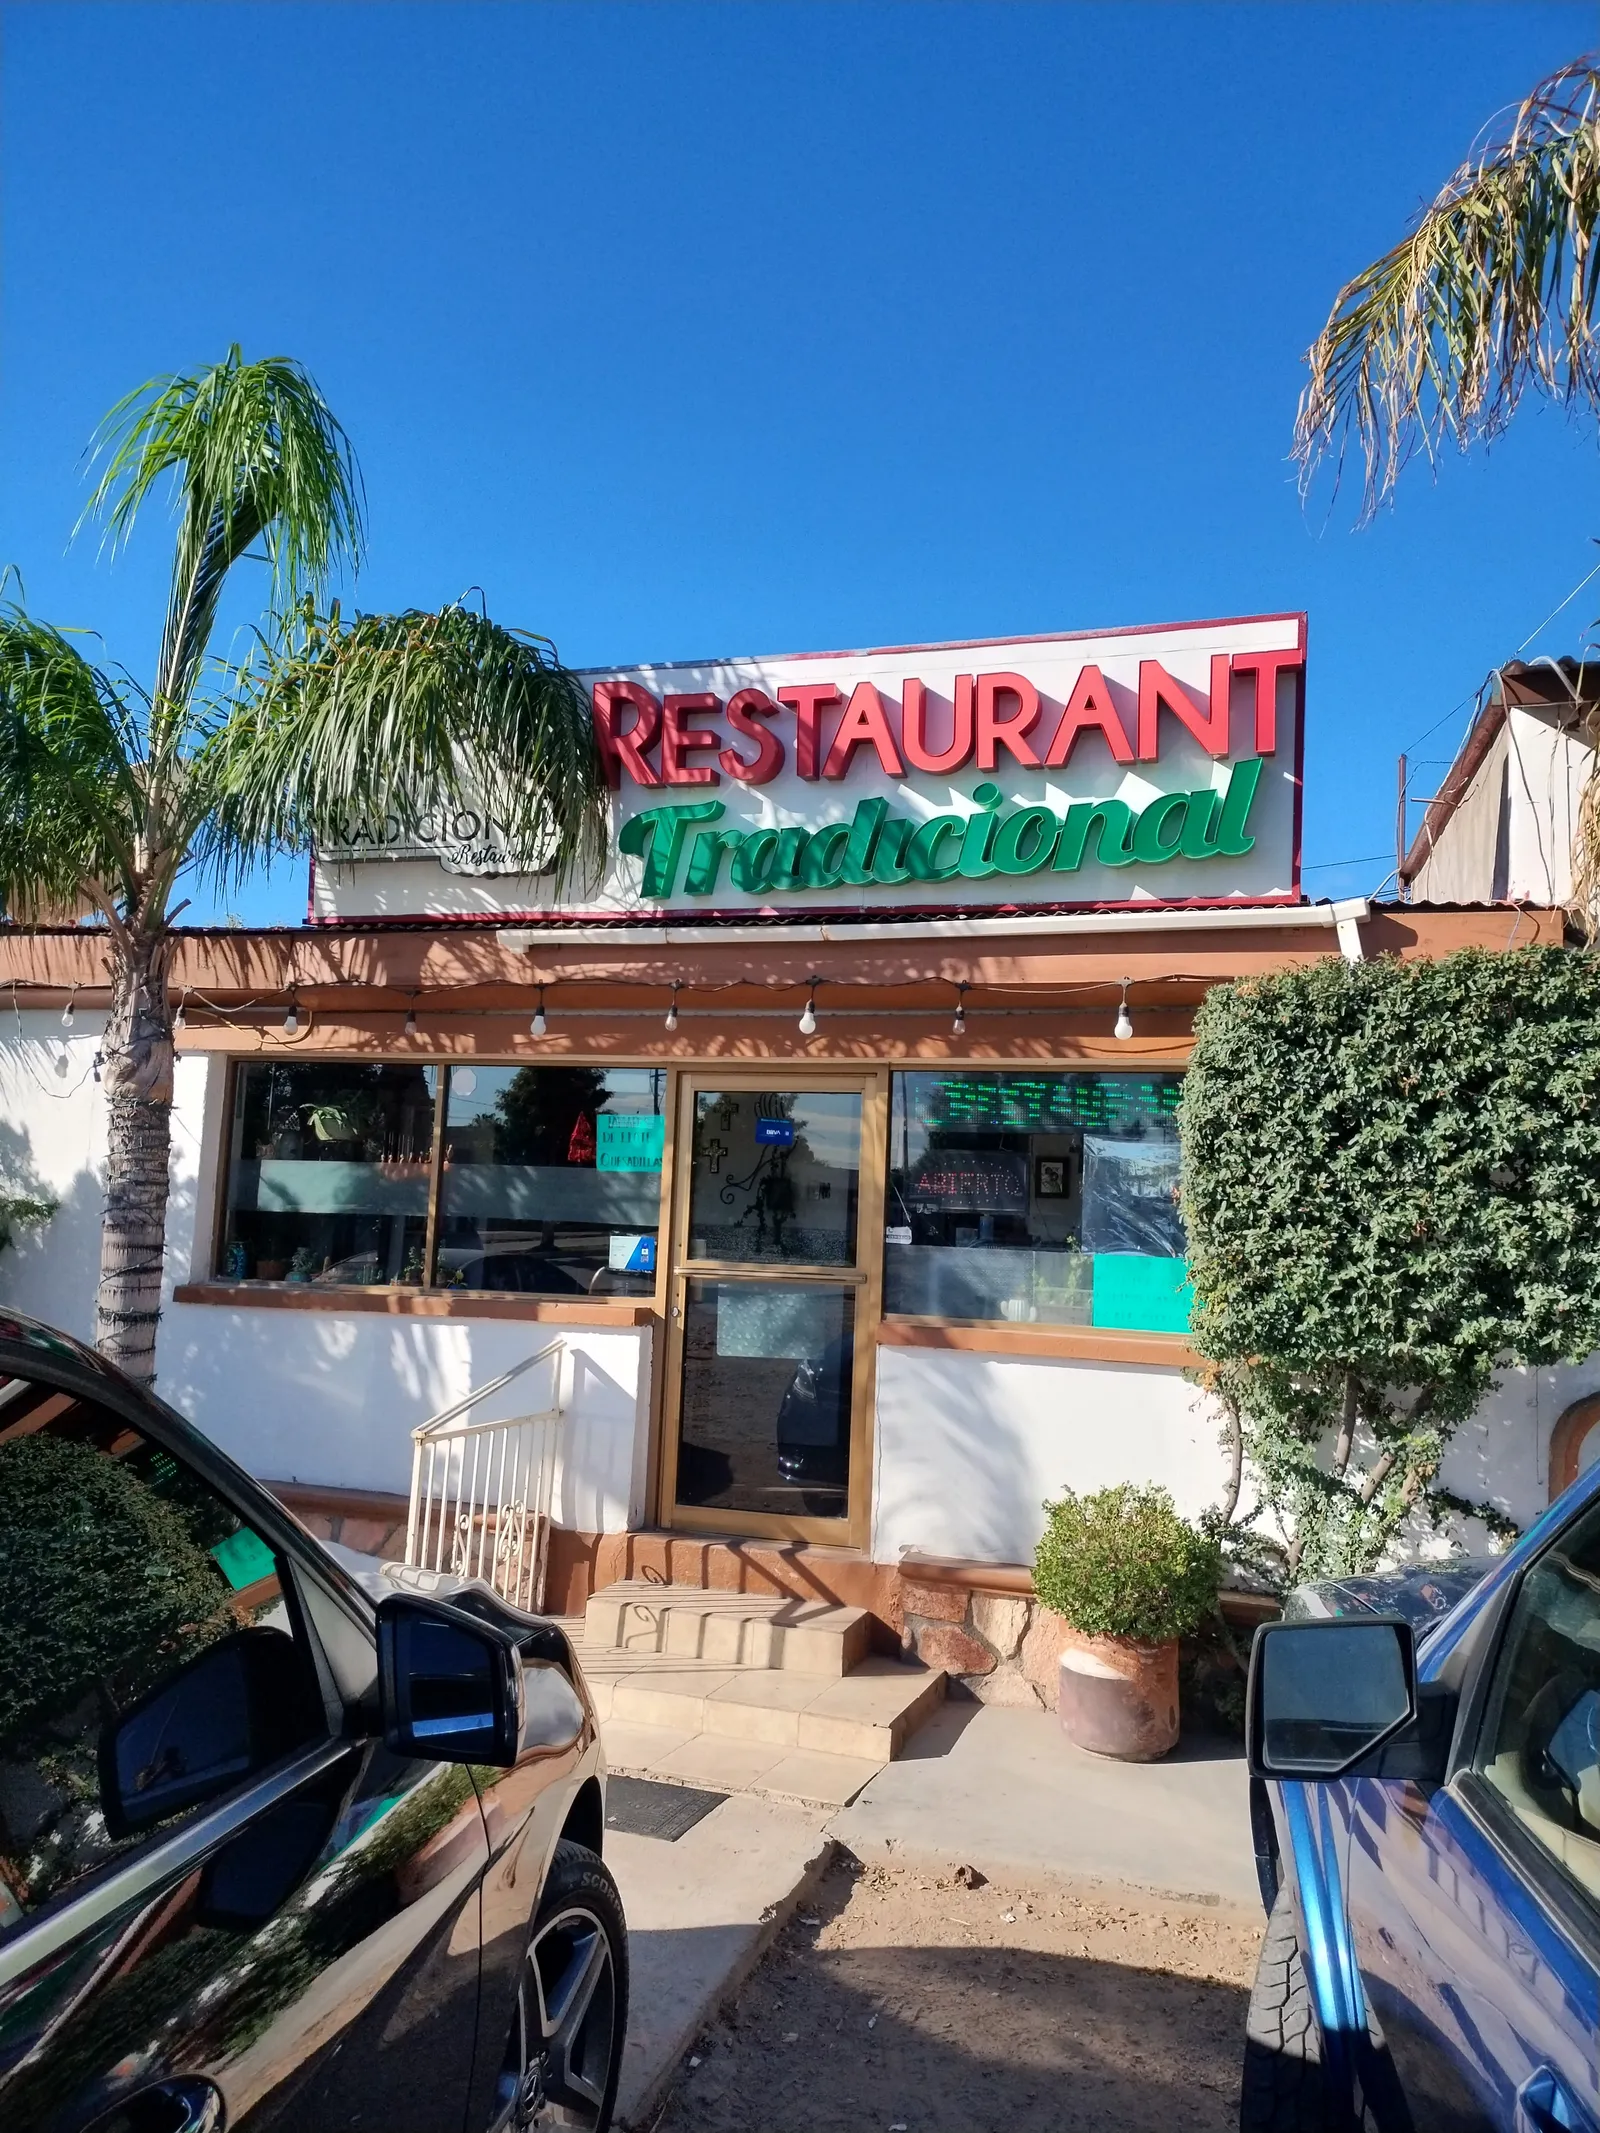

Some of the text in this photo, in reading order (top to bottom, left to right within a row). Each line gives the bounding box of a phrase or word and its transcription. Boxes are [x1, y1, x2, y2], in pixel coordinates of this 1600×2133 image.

[593, 647, 1304, 791] RESTAURANT
[618, 757, 1264, 900] Tradicional
[917, 1172, 1020, 1195] ABIERTO
